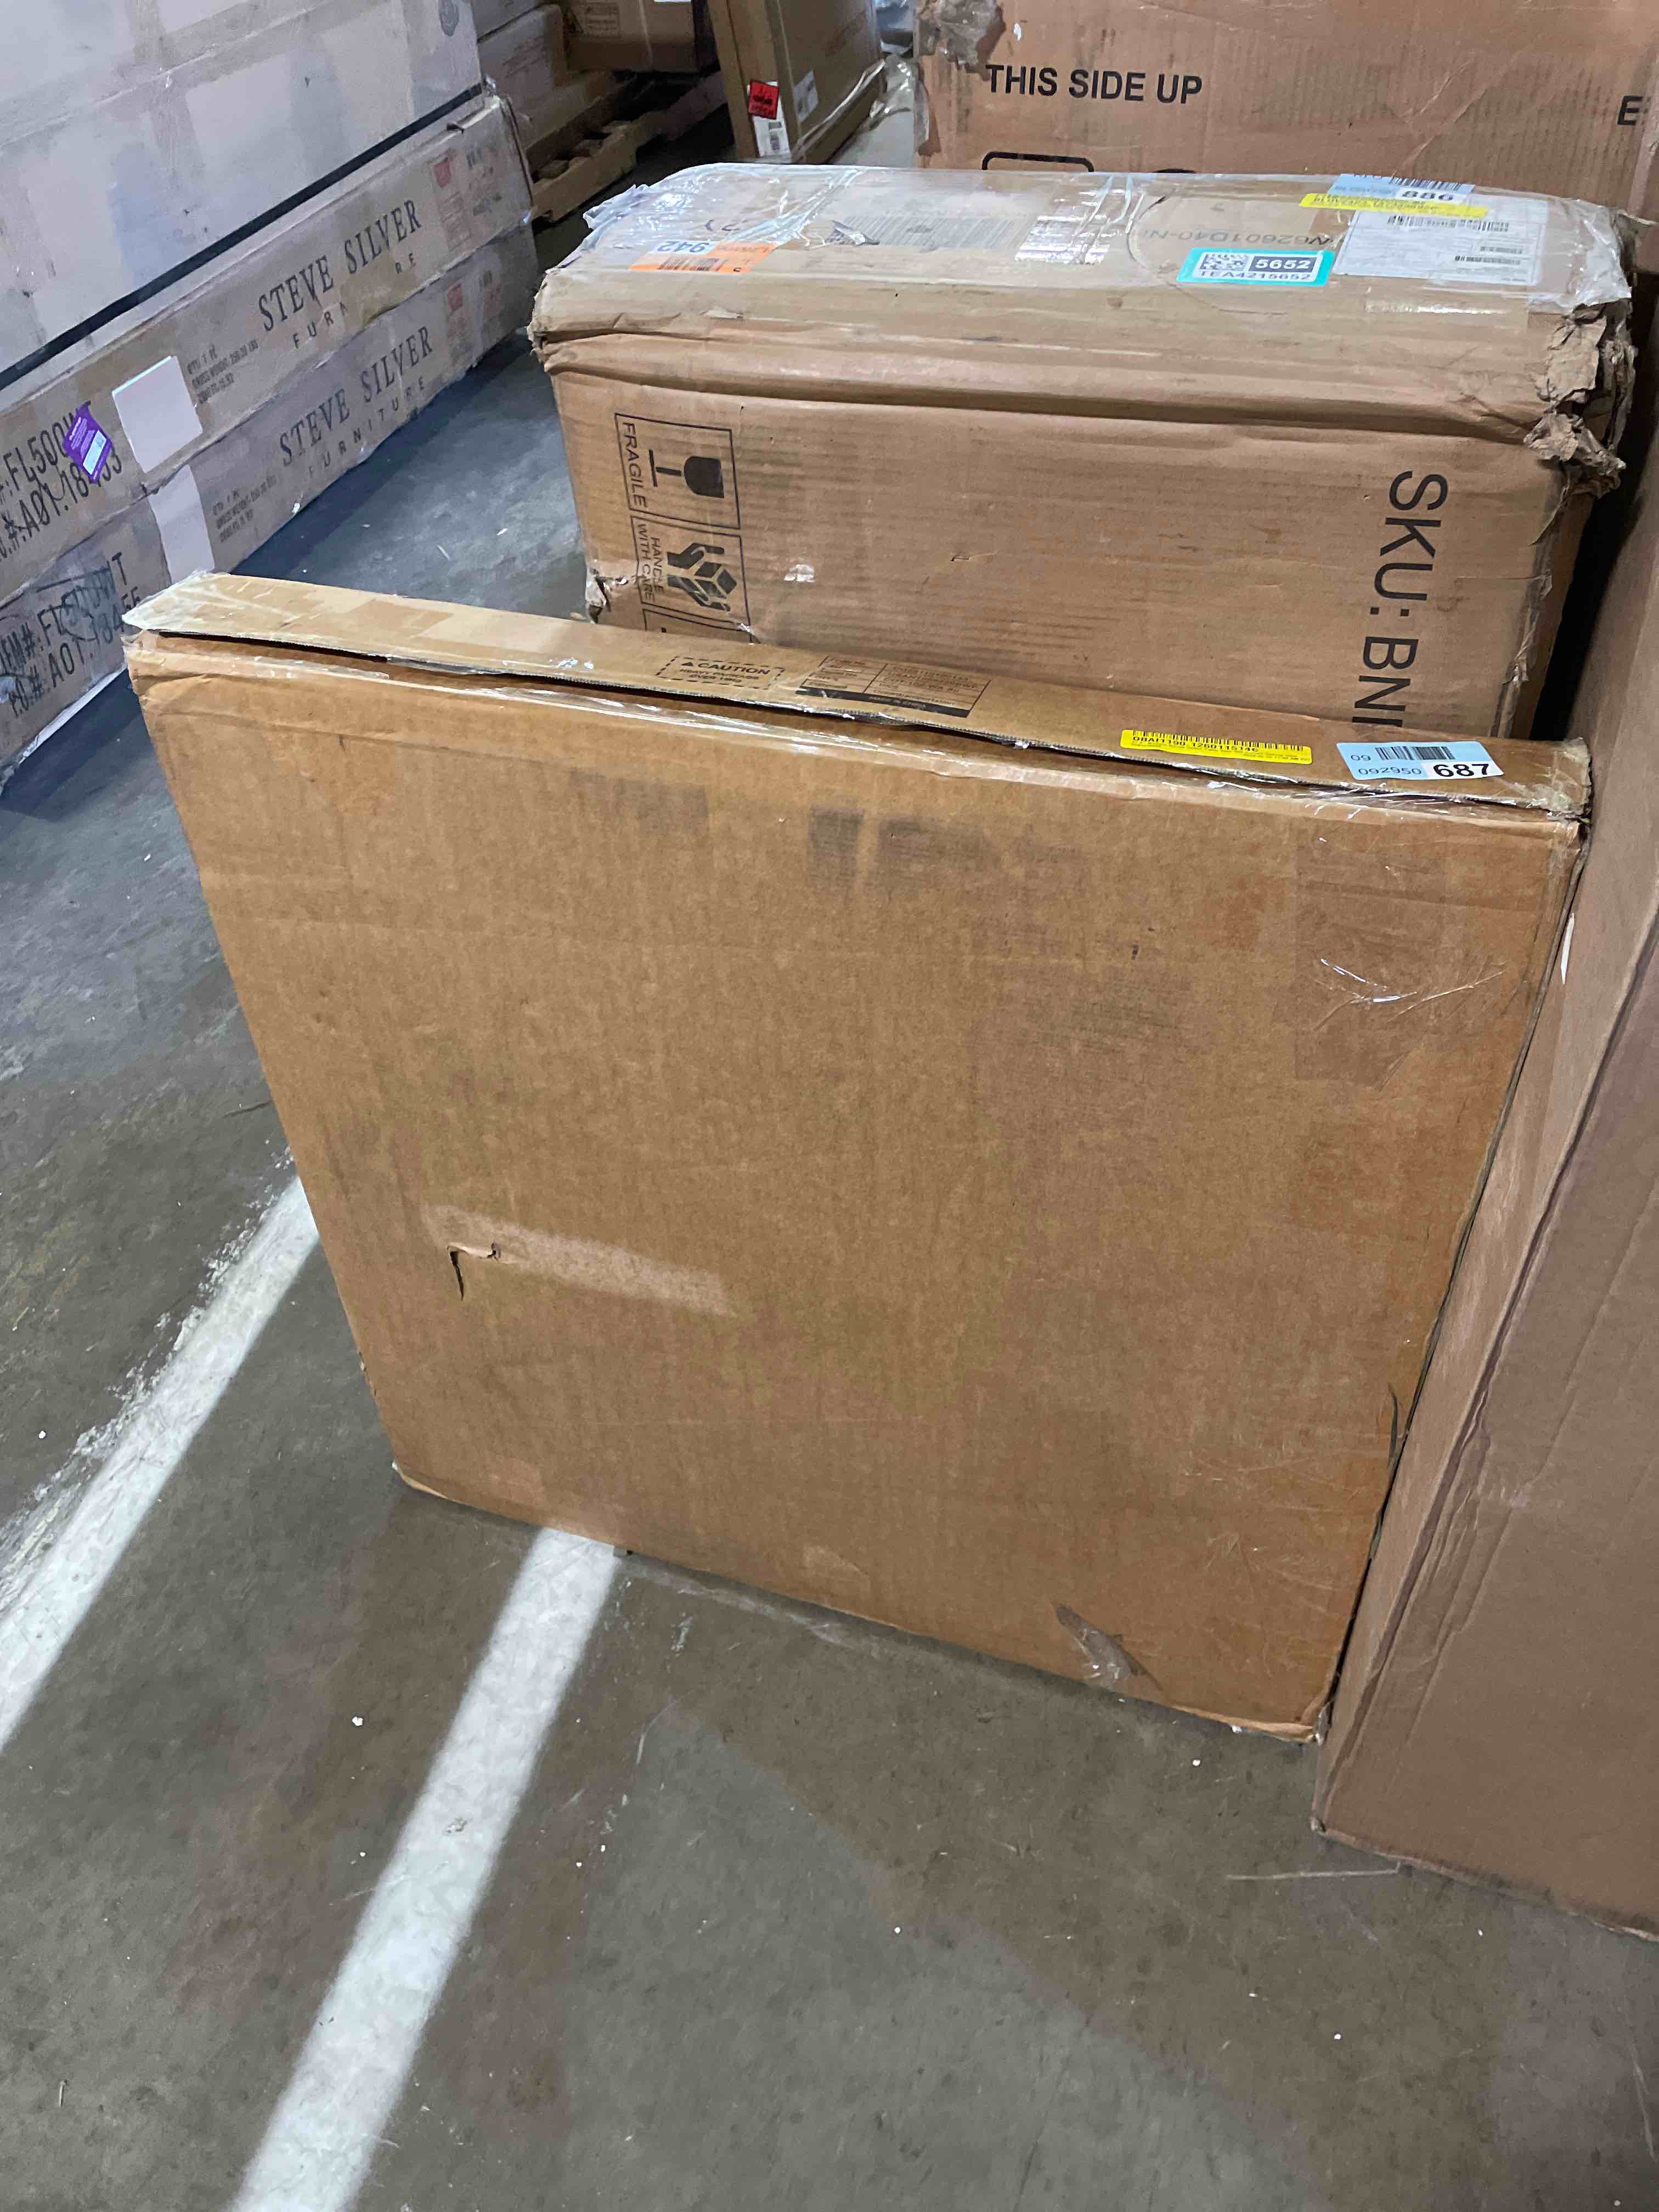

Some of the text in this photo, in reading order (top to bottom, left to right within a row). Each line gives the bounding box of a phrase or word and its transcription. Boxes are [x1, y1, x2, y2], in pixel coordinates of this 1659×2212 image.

[985, 64, 1203, 104] THIS SIDE UP
[258, 255, 334, 331] STEVE
[345, 200, 422, 274] SILVER
[1255, 259, 1311, 270] 5652
[280, 388, 350, 467] STEVE
[360, 326, 433, 403] SILVER
[309, 377, 426, 478] FURNITURE
[623, 421, 648, 508] FRAGILE
[637, 523, 651, 560] WITH
[1370, 470, 1448, 617] SKU:
[698, 663, 771, 675] CAUTION
[1432, 763, 1489, 777] 687
